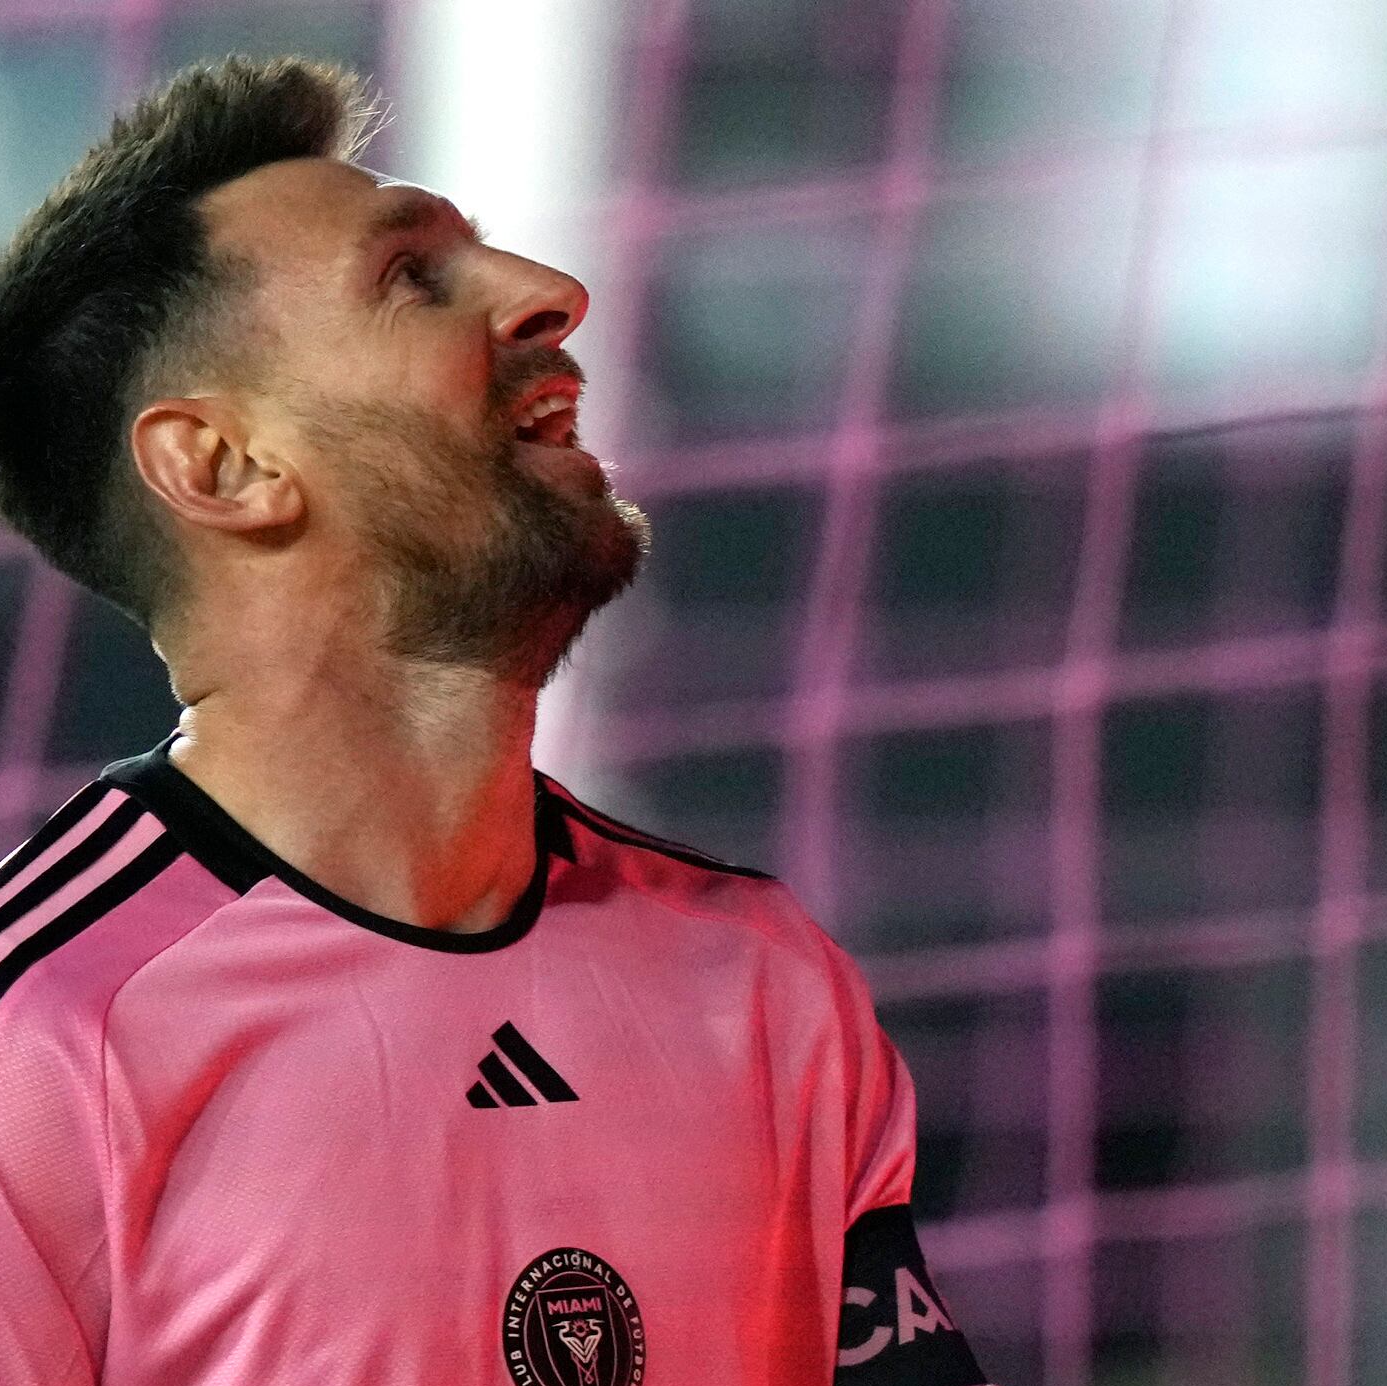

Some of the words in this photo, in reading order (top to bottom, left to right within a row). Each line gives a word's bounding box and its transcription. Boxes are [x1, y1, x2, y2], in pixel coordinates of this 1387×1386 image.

[508, 1253, 612, 1338] INTERNACIONAL
[616, 1284, 633, 1309] DE
[547, 1297, 602, 1316] MIAMI
[838, 1267, 956, 1367] CA
